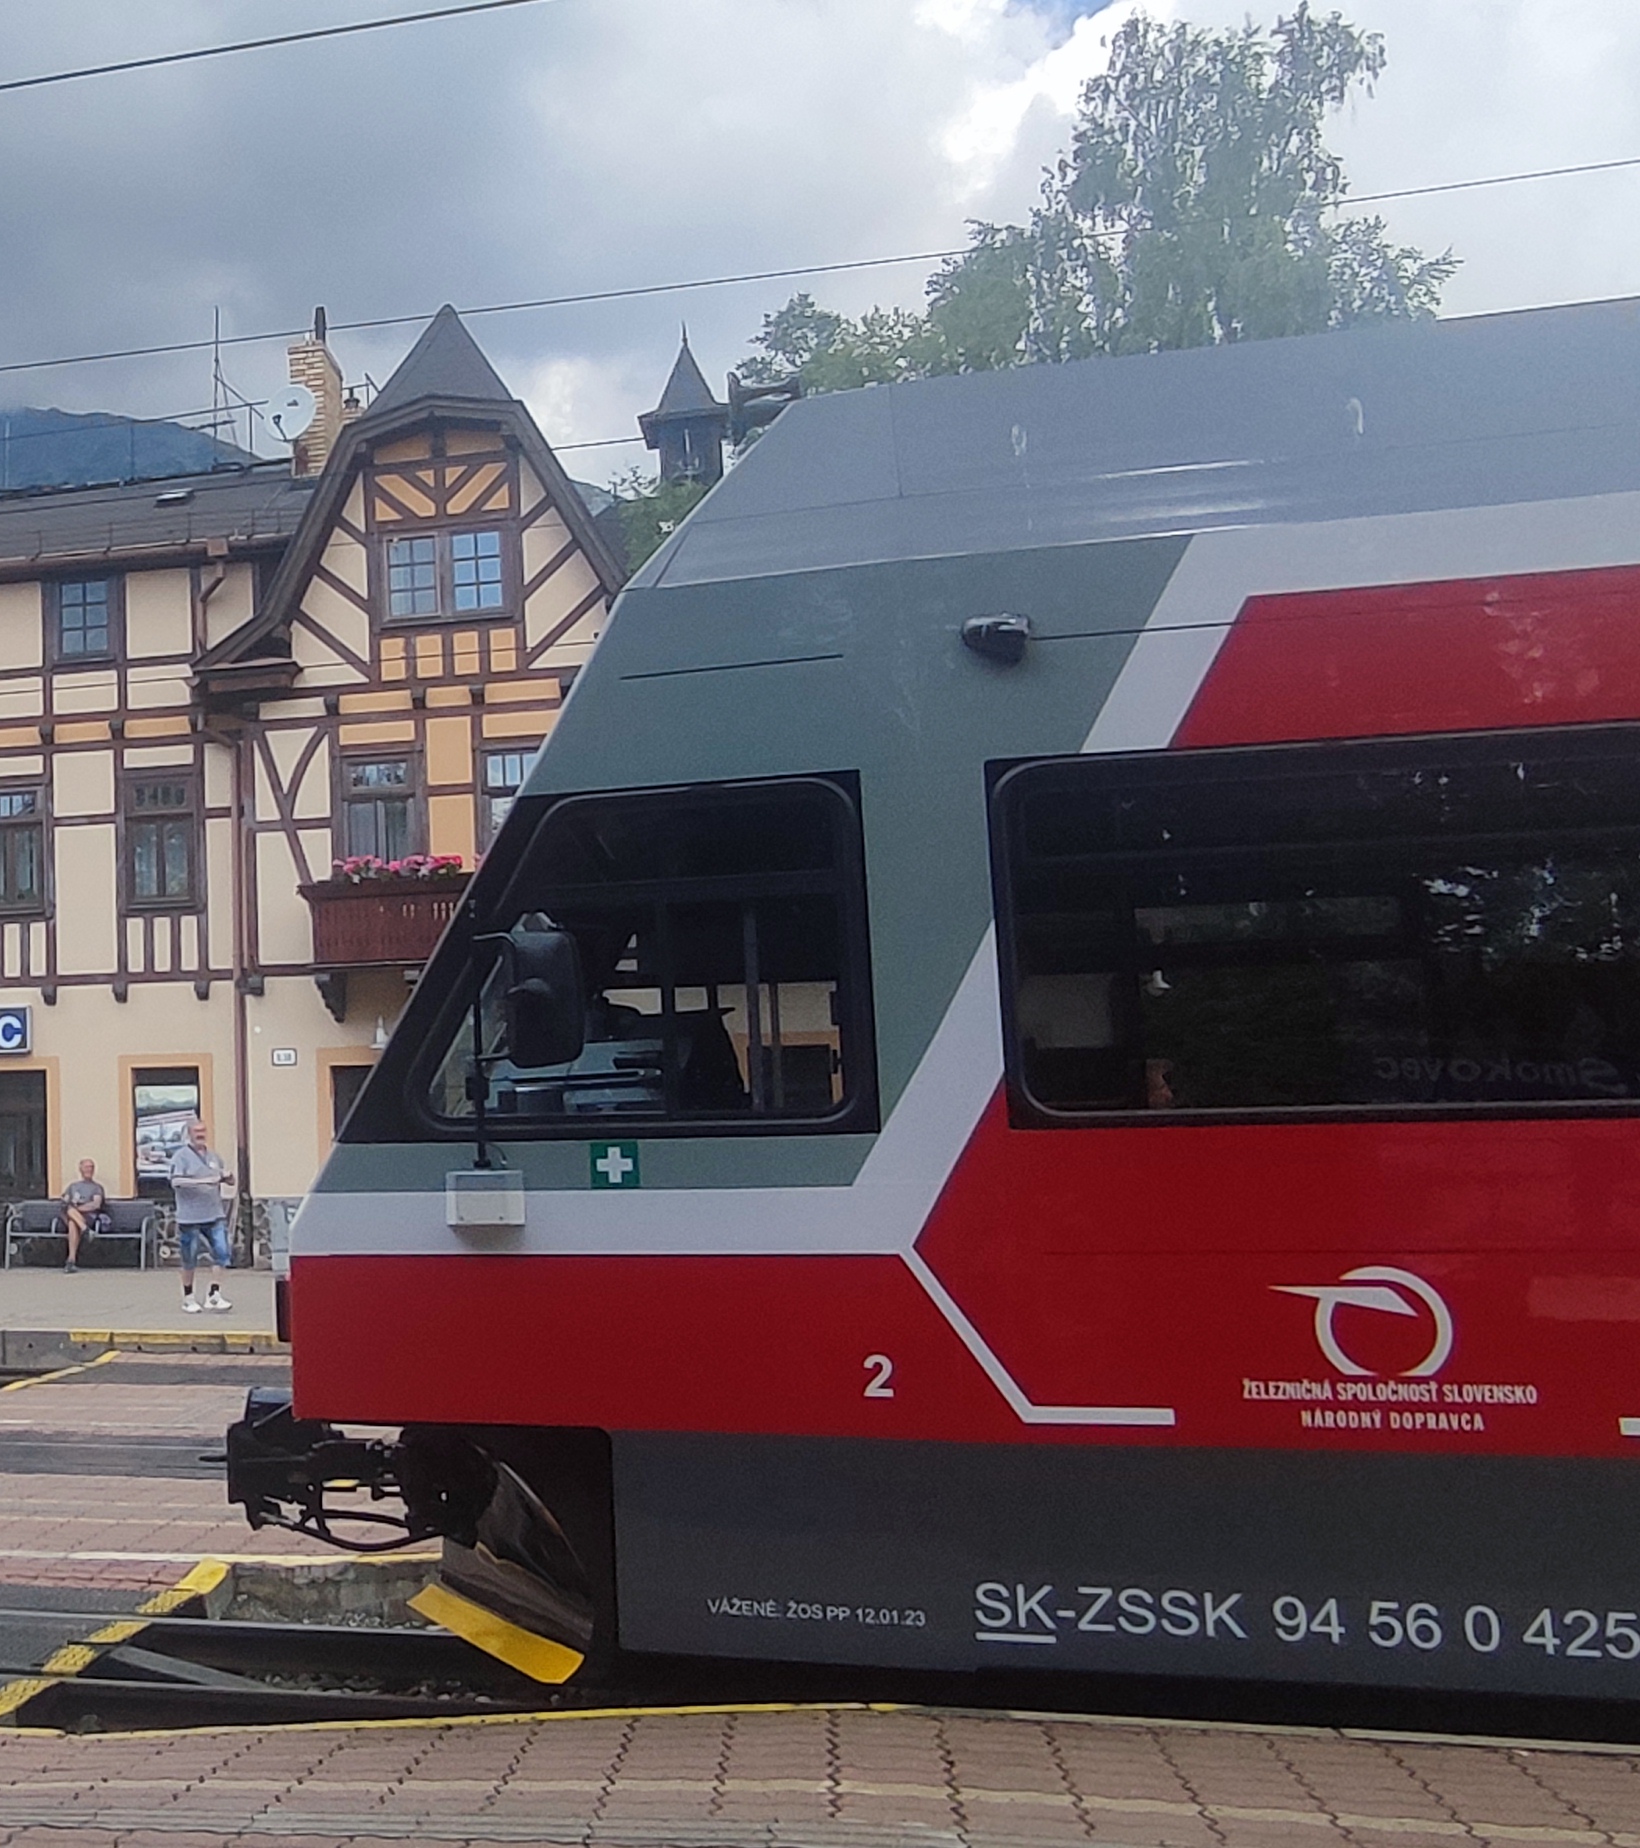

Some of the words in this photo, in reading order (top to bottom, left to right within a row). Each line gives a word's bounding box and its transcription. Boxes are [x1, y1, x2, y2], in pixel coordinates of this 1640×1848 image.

[863, 1354, 895, 1398] 2
[1242, 1378, 1334, 1400] ŽELEZNIČNÁ
[1336, 1380, 1439, 1402] SPOLOČNOSŤ
[1442, 1383, 1538, 1404] SLOVENSKO
[1299, 1407, 1382, 1428] NÁRODNÝ
[1388, 1411, 1486, 1431] DOPRAVCA
[786, 1599, 824, 1619] ŽOS
[826, 1606, 851, 1621] PP
[855, 1608, 927, 1627] 12.01.23
[974, 1582, 1249, 1643] SK-ZSSK
[1271, 1595, 1346, 1645] 94
[1367, 1600, 1443, 1650] 56
[1463, 1604, 1501, 1653] 0
[1522, 1607, 1640, 1660] 425
